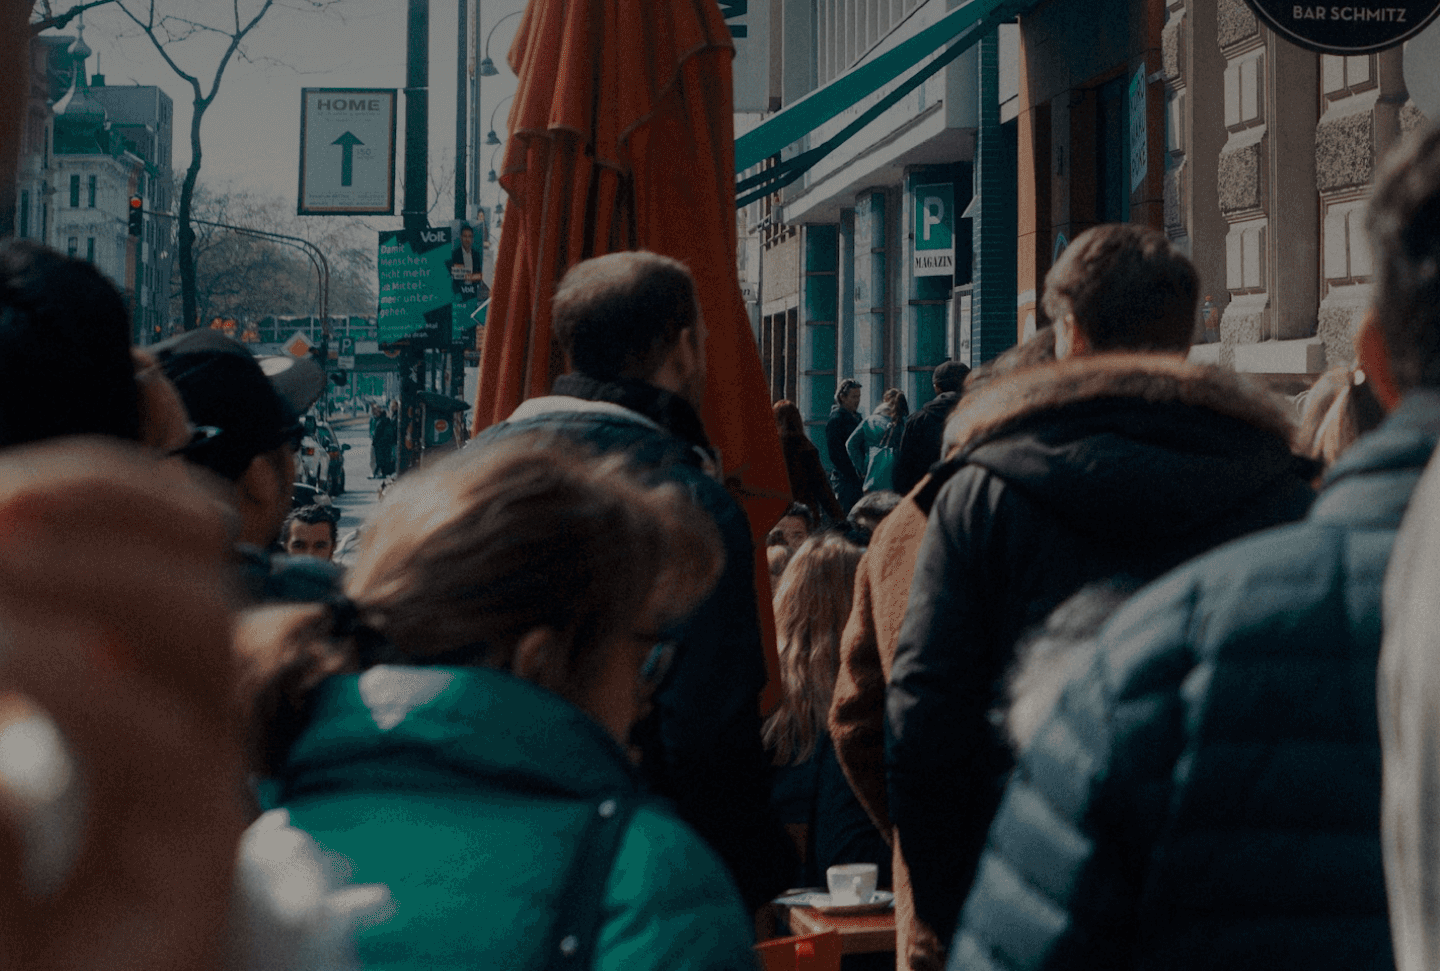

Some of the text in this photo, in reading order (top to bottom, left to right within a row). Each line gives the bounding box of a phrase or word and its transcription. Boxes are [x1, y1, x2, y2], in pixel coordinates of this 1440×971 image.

[1292, 5, 1408, 22] BAR SCHMITZ
[317, 99, 380, 111] HOME
[923, 195, 945, 241] P
[420, 231, 447, 243] Volt
[381, 255, 428, 266] Menschen
[915, 256, 953, 269] MAGAZIN
[403, 268, 431, 278] mehr
